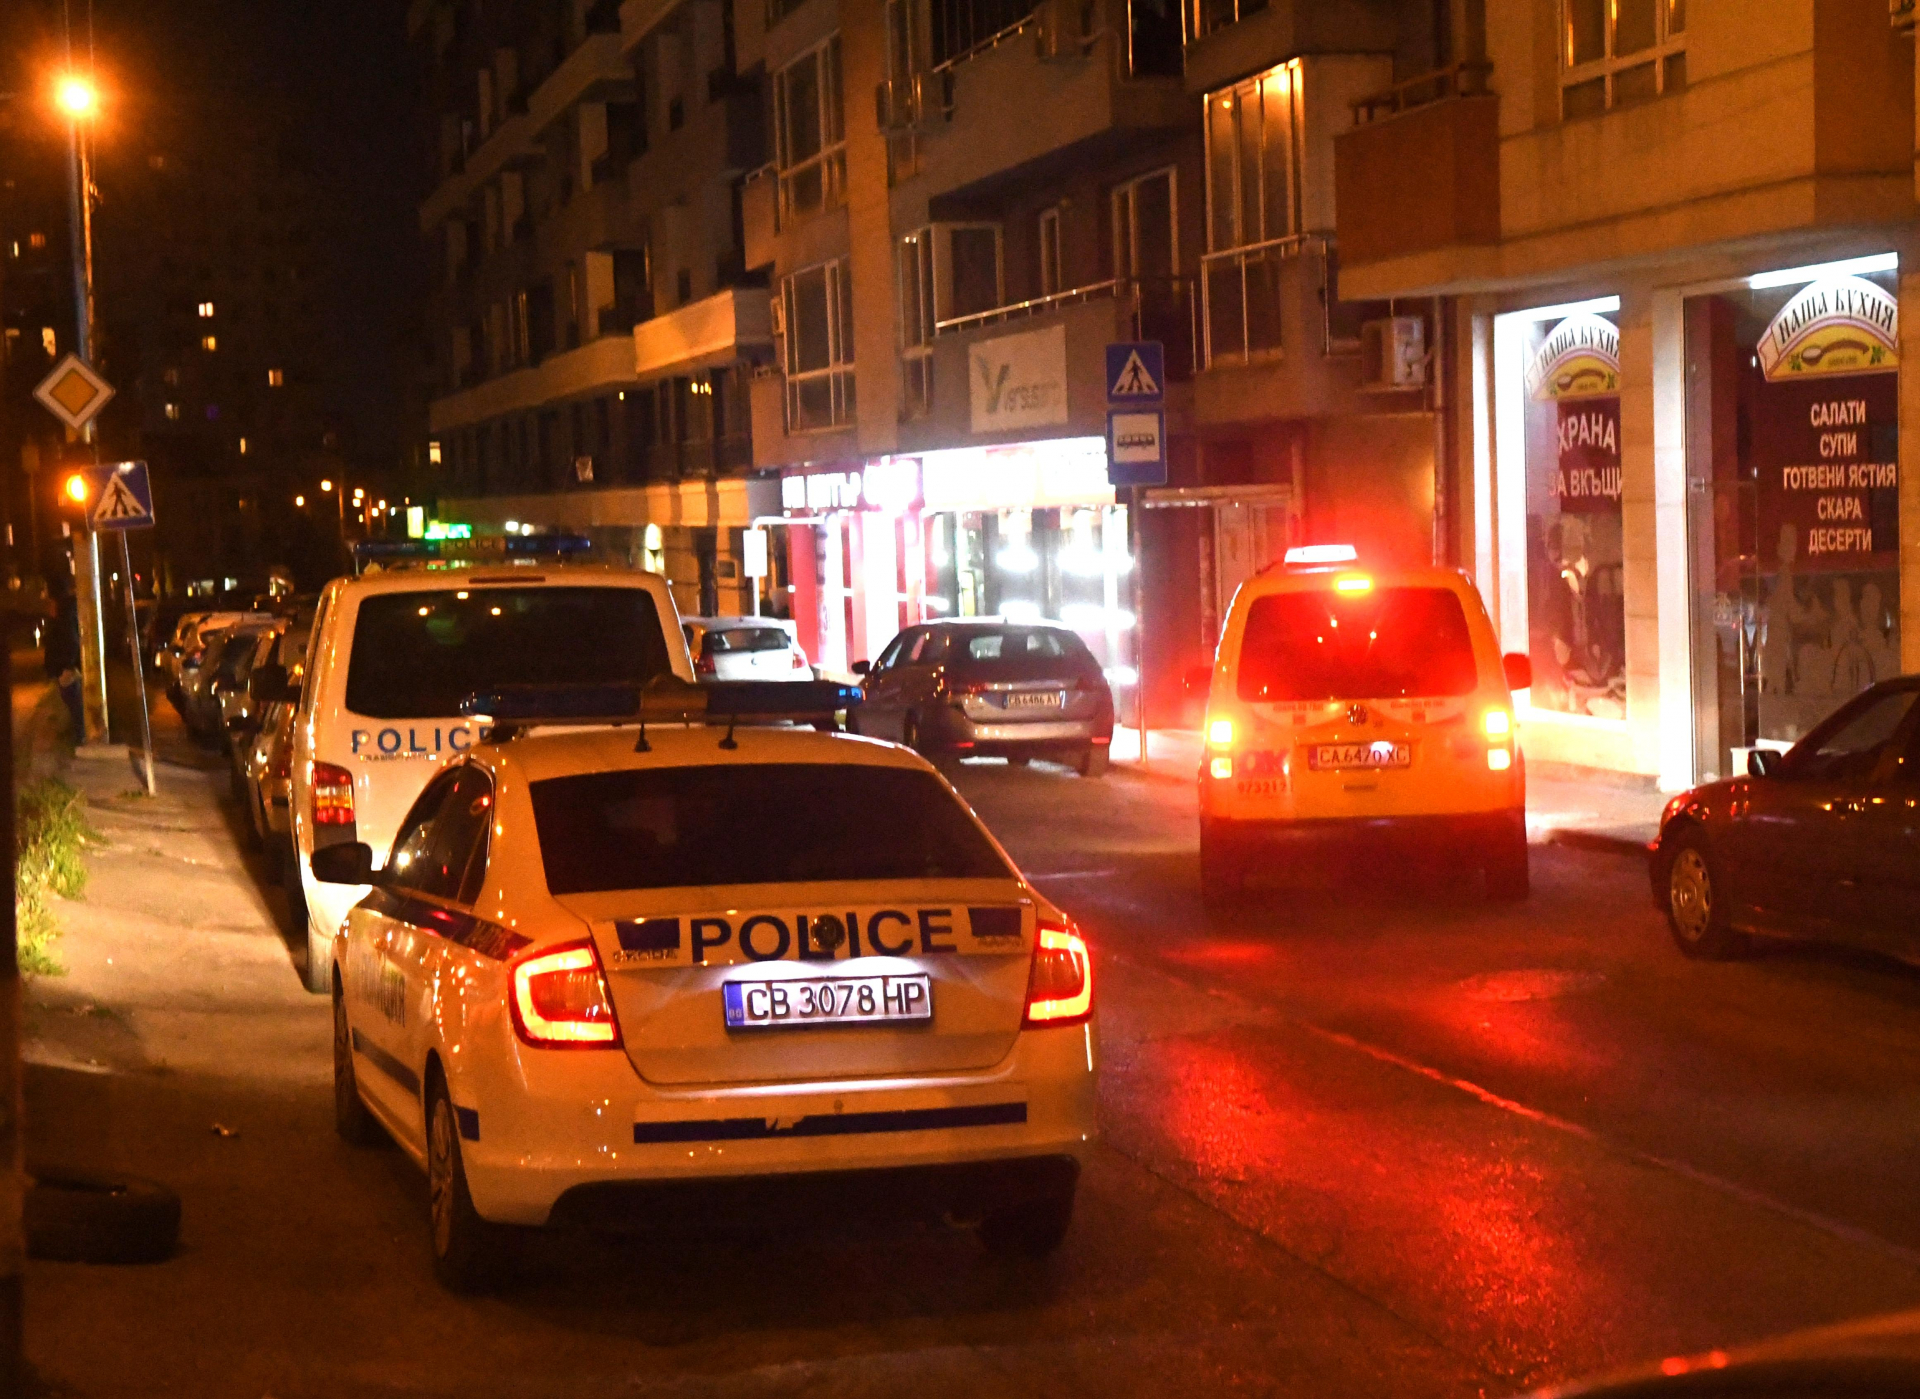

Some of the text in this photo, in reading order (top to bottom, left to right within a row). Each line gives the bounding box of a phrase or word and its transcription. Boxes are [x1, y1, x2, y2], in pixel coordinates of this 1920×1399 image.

[1778, 291, 1828, 345] НАША
[1810, 400, 1866, 427] САЛАТИ
[1557, 413, 1616, 455] ХРАНА
[1820, 432, 1857, 458] СУПИ
[1783, 463, 1896, 490] ГОТВЕНИ ЯСТИЯ
[1817, 497, 1862, 520] СКАРА
[1808, 528, 1872, 555] ДЕСЕРТИ
[690, 910, 957, 963] POLICE
[747, 980, 925, 1020] CB 3078 HP
